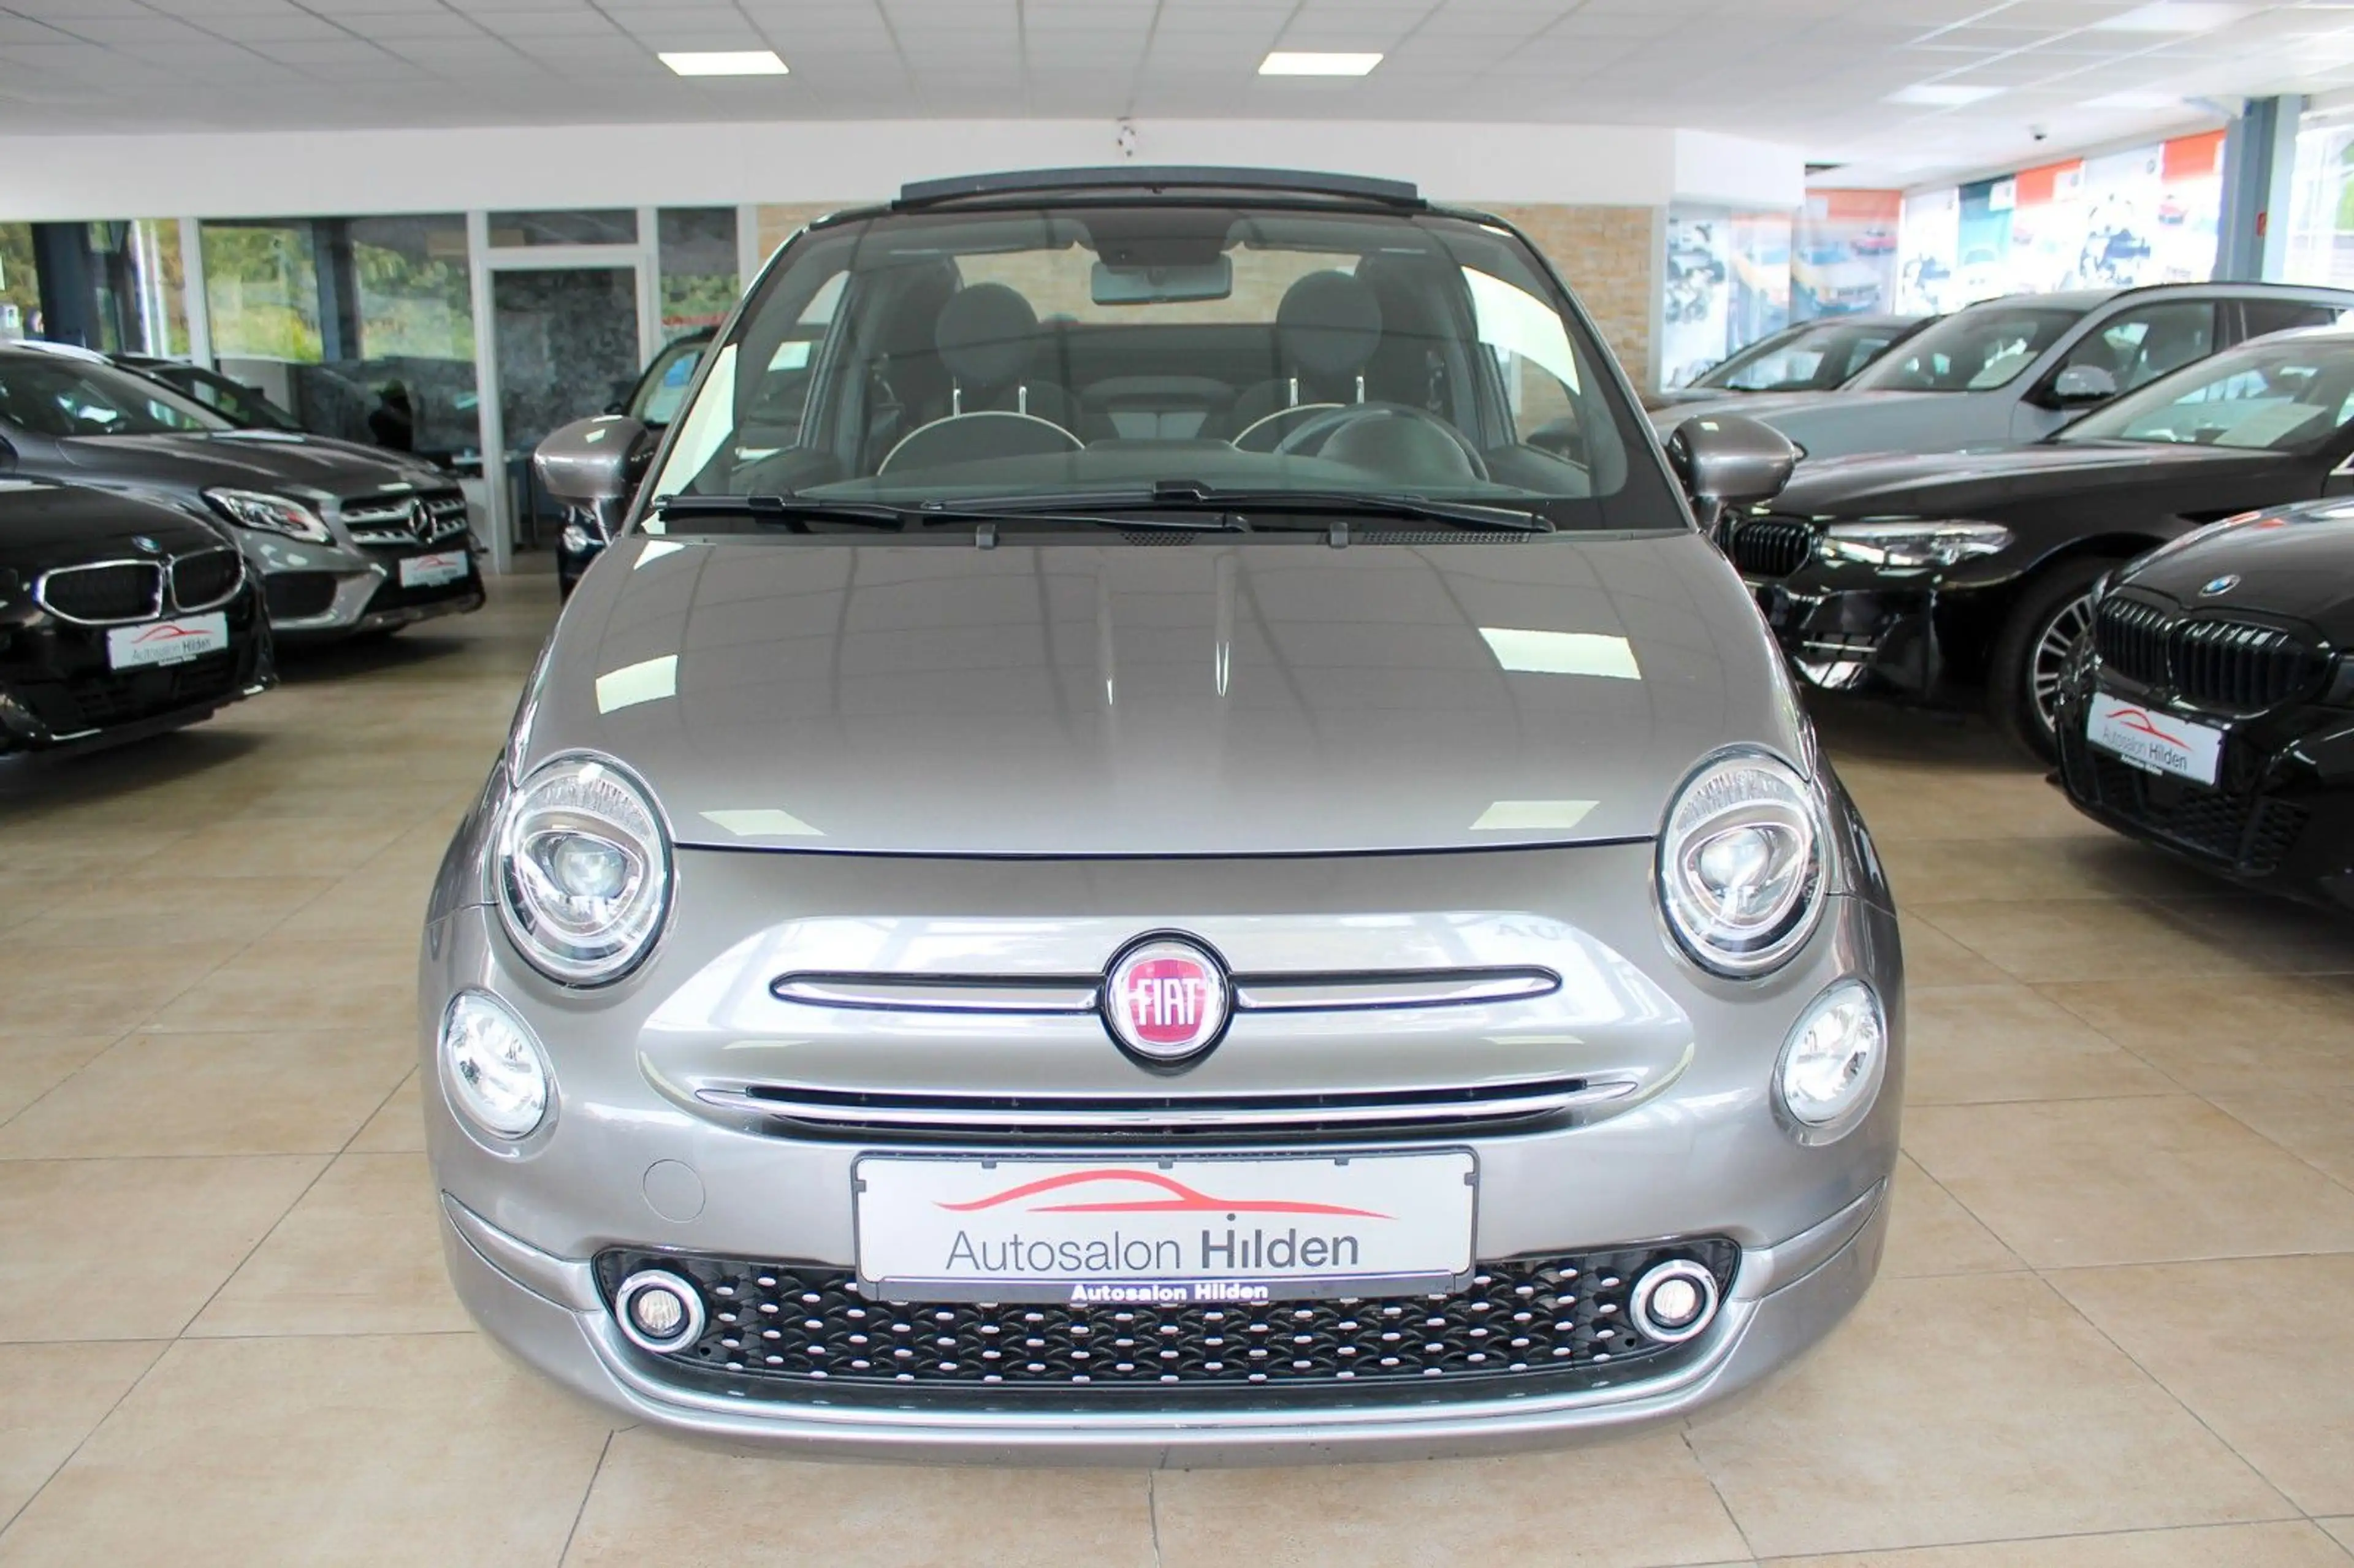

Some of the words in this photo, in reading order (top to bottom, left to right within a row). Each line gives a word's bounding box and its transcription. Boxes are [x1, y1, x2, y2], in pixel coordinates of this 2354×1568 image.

[2148, 742, 2188, 771] Hilden
[1137, 977, 1200, 1026] FIAT
[945, 1229, 1181, 1271] Autosalon
[1200, 1212, 1359, 1269] Hilden
[1070, 1284, 1189, 1303] Autosalon
[1194, 1282, 1269, 1301] Hilden
